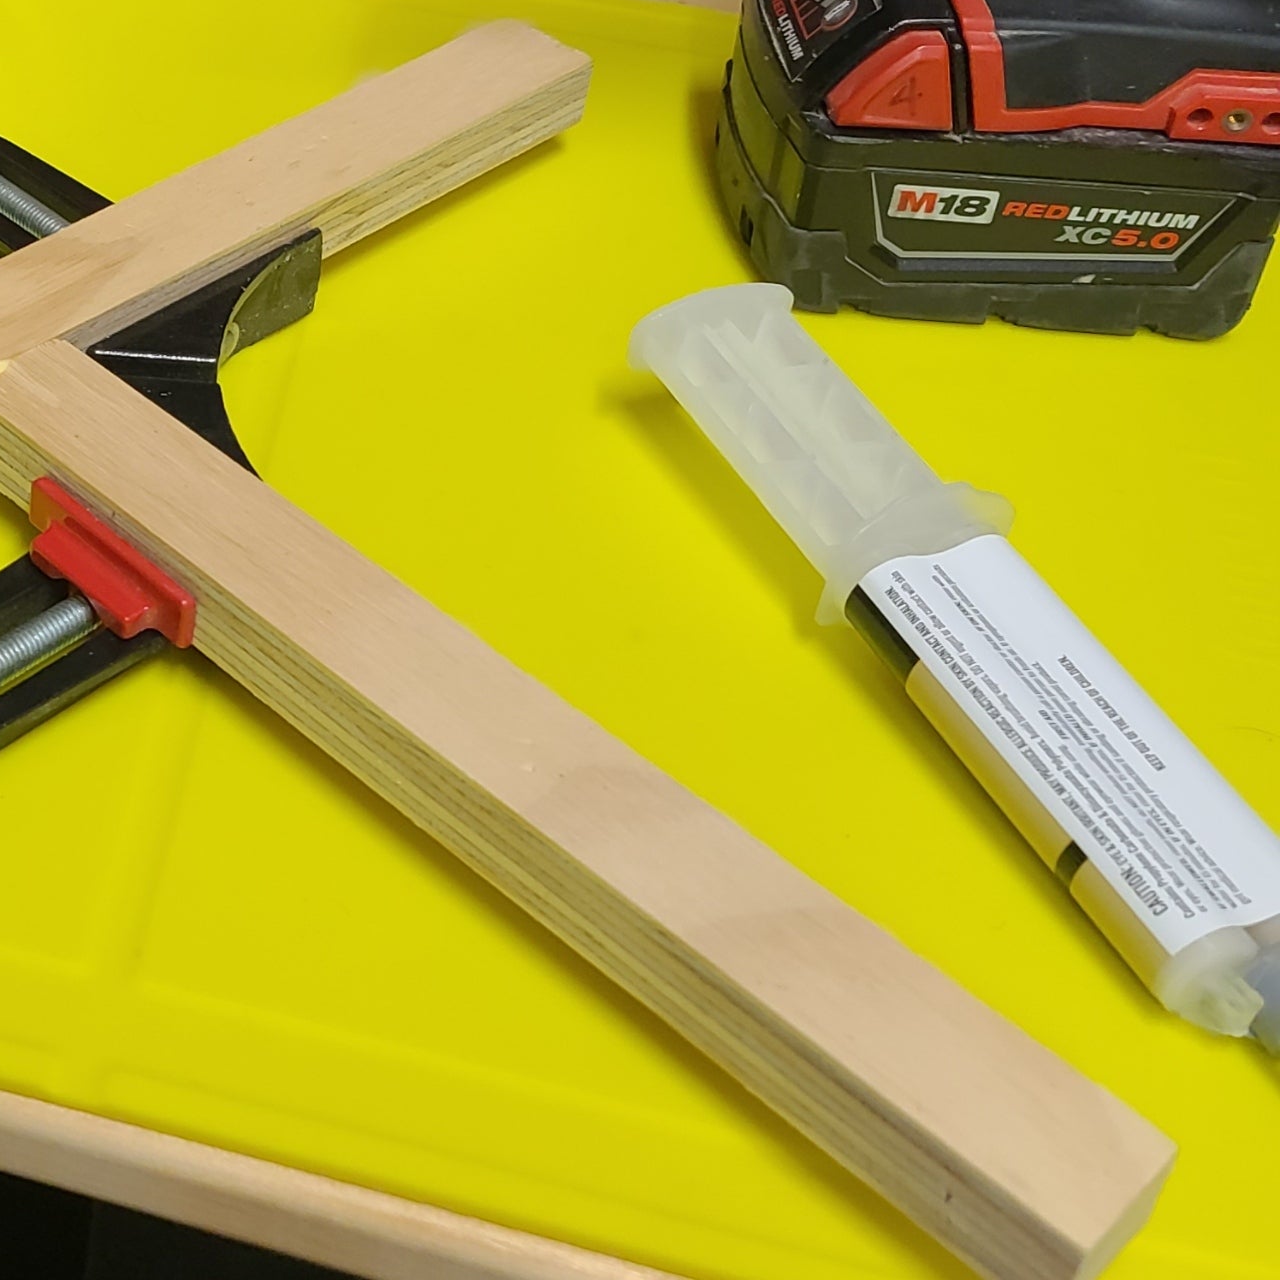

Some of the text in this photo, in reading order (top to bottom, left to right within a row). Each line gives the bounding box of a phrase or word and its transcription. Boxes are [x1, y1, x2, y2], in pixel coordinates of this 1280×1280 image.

[896, 190, 1201, 231] M18 REDLITHIUM
[912, 620, 932, 638] AND
[922, 632, 955, 665] CONTACT
[946, 660, 969, 681] SKIN
[959, 675, 975, 688] BY
[1083, 685, 1101, 698] OF
[966, 683, 1002, 719] REACTION
[1091, 695, 1119, 719] REACH
[993, 714, 1028, 750] ALLERGIC
[1109, 715, 1130, 731] THE
[1121, 728, 1139, 741] OF
[1129, 737, 1151, 754] OUT
[1019, 744, 1055, 781] PRODUCE
[1141, 751, 1166, 771] KEEP
[1045, 776, 1068, 796] MAY
[1086, 824, 1111, 847] SKIN
[1116, 862, 1170, 917] CAUTION:
